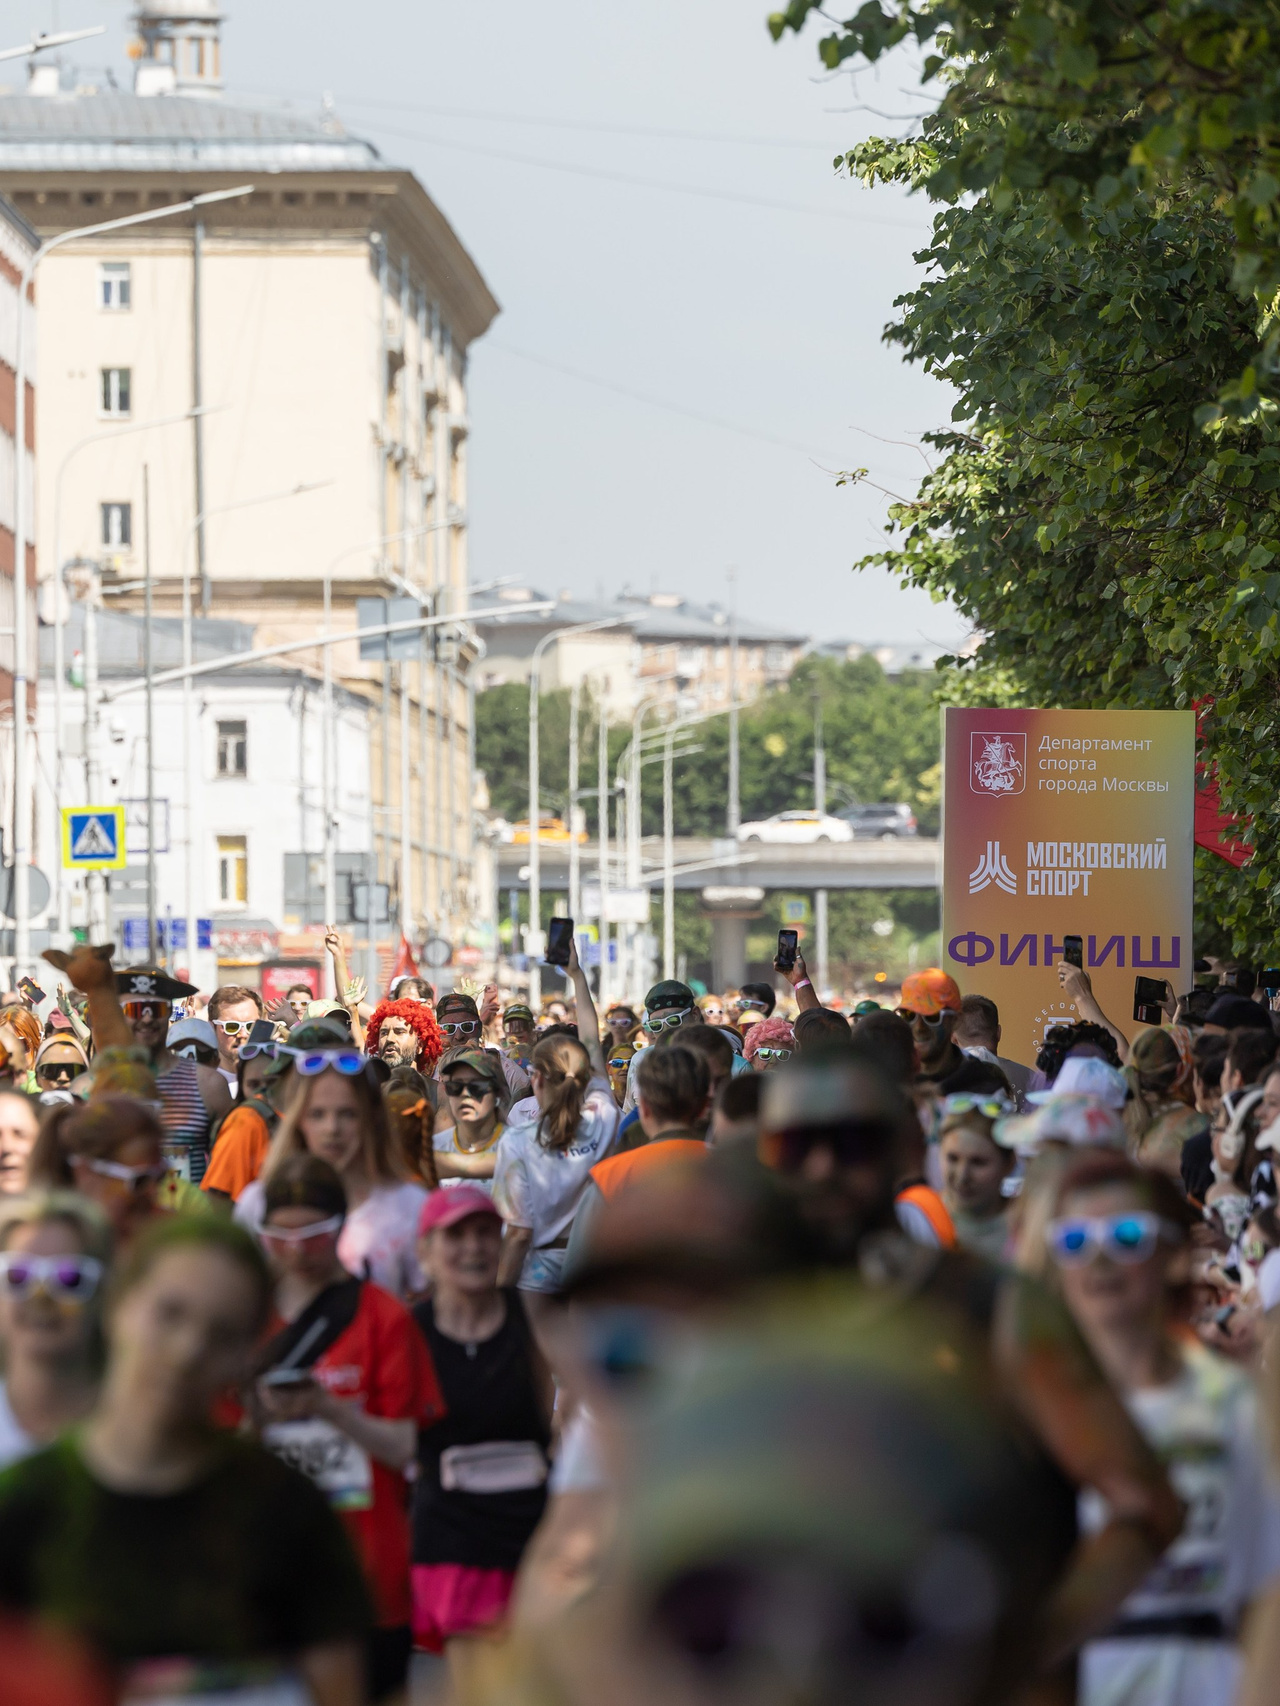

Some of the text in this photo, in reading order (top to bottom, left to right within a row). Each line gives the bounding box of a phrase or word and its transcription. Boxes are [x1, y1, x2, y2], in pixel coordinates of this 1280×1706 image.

[1038, 735, 1153, 752] Департамент
[1038, 757, 1097, 774] спорта
[1038, 777, 1169, 794] города Москвы
[1027, 838, 1167, 869] МОСКОВСКИЙ
[1027, 870, 1092, 896] СПОРТ
